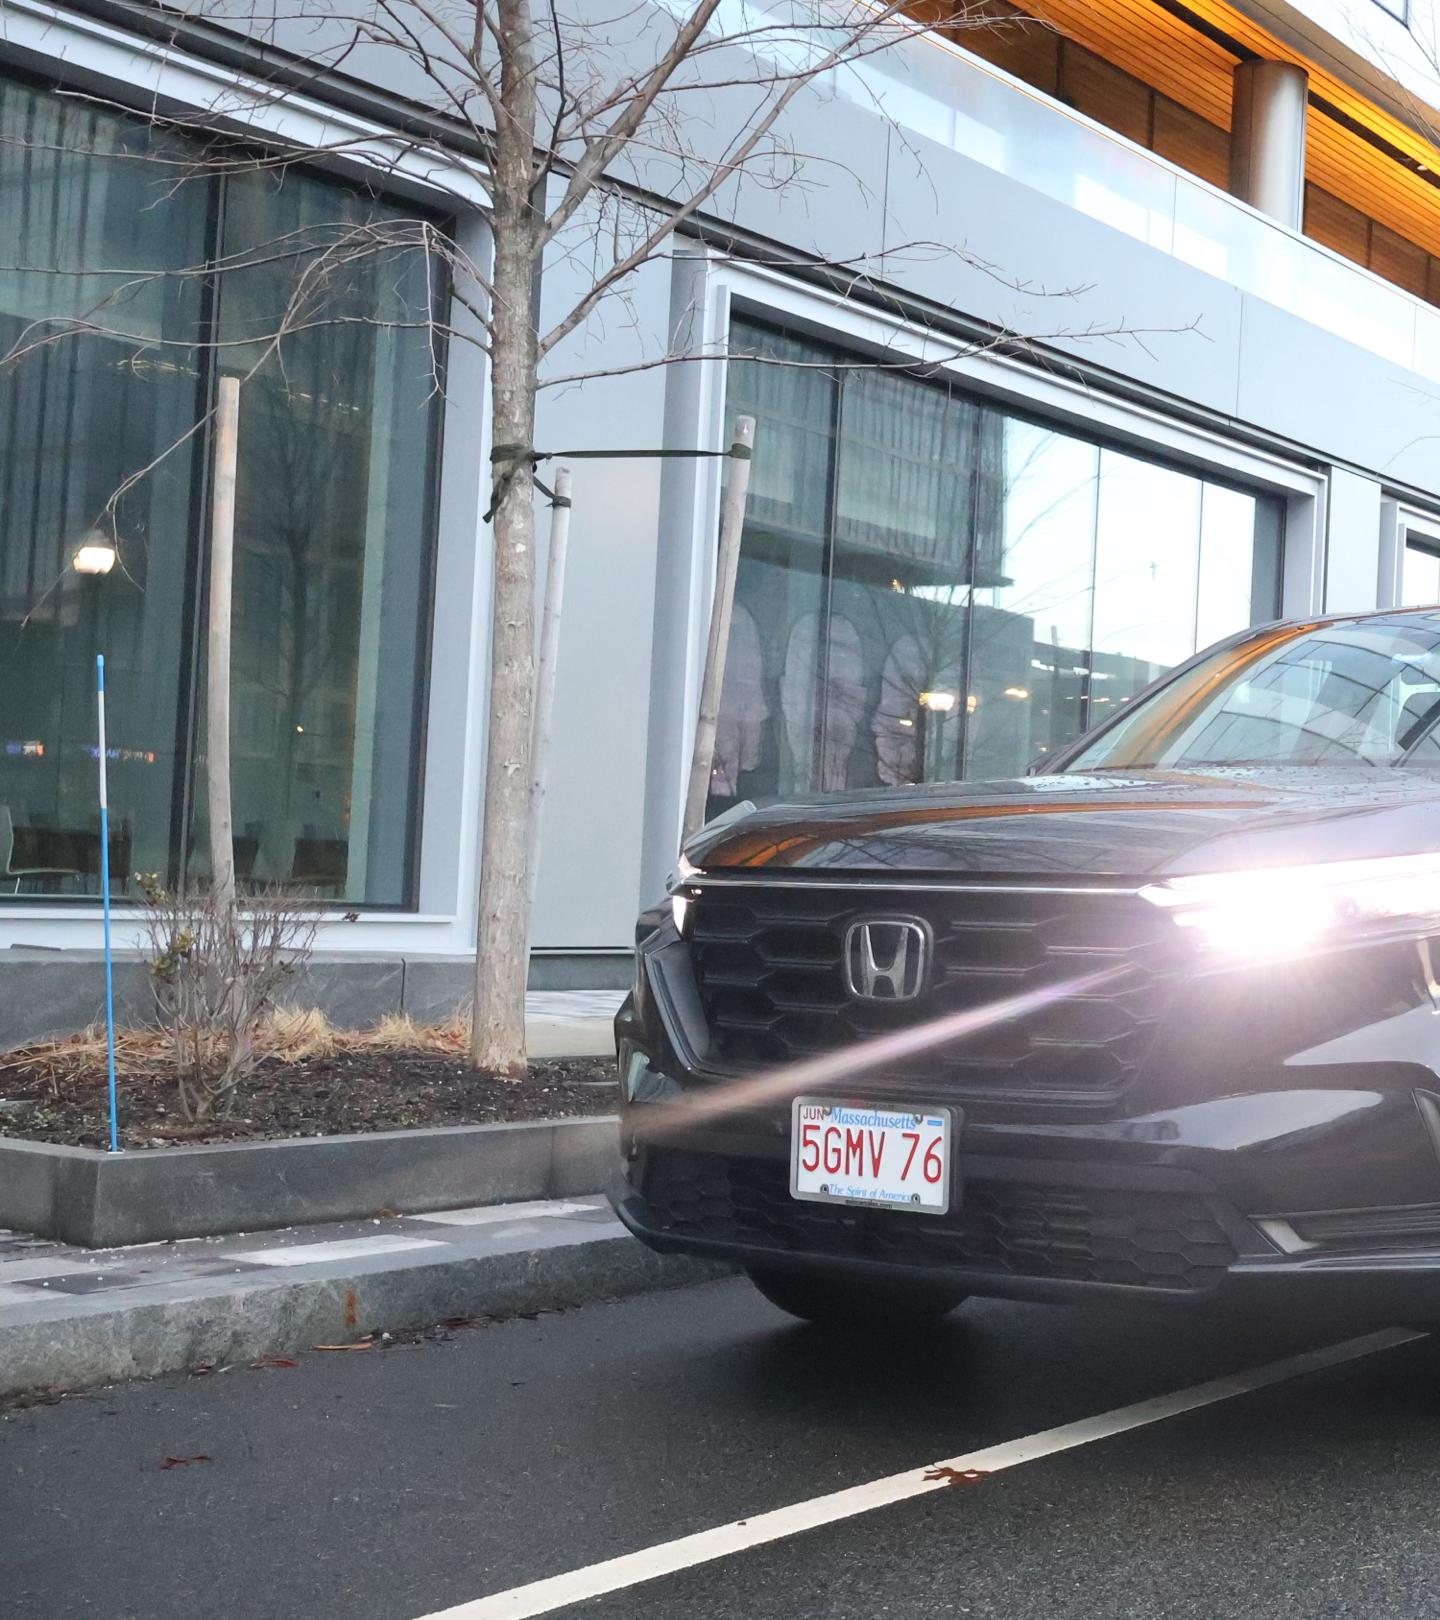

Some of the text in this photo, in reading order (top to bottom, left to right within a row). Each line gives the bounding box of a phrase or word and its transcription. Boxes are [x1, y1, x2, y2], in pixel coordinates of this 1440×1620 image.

[802, 1107, 825, 1121] JUN
[831, 1106, 917, 1130] Massachusetts
[802, 1124, 943, 1184] 5GMV 76
[829, 1183, 845, 1194] The
[847, 1185, 868, 1198] Spirit
[869, 1188, 878, 1197] of
